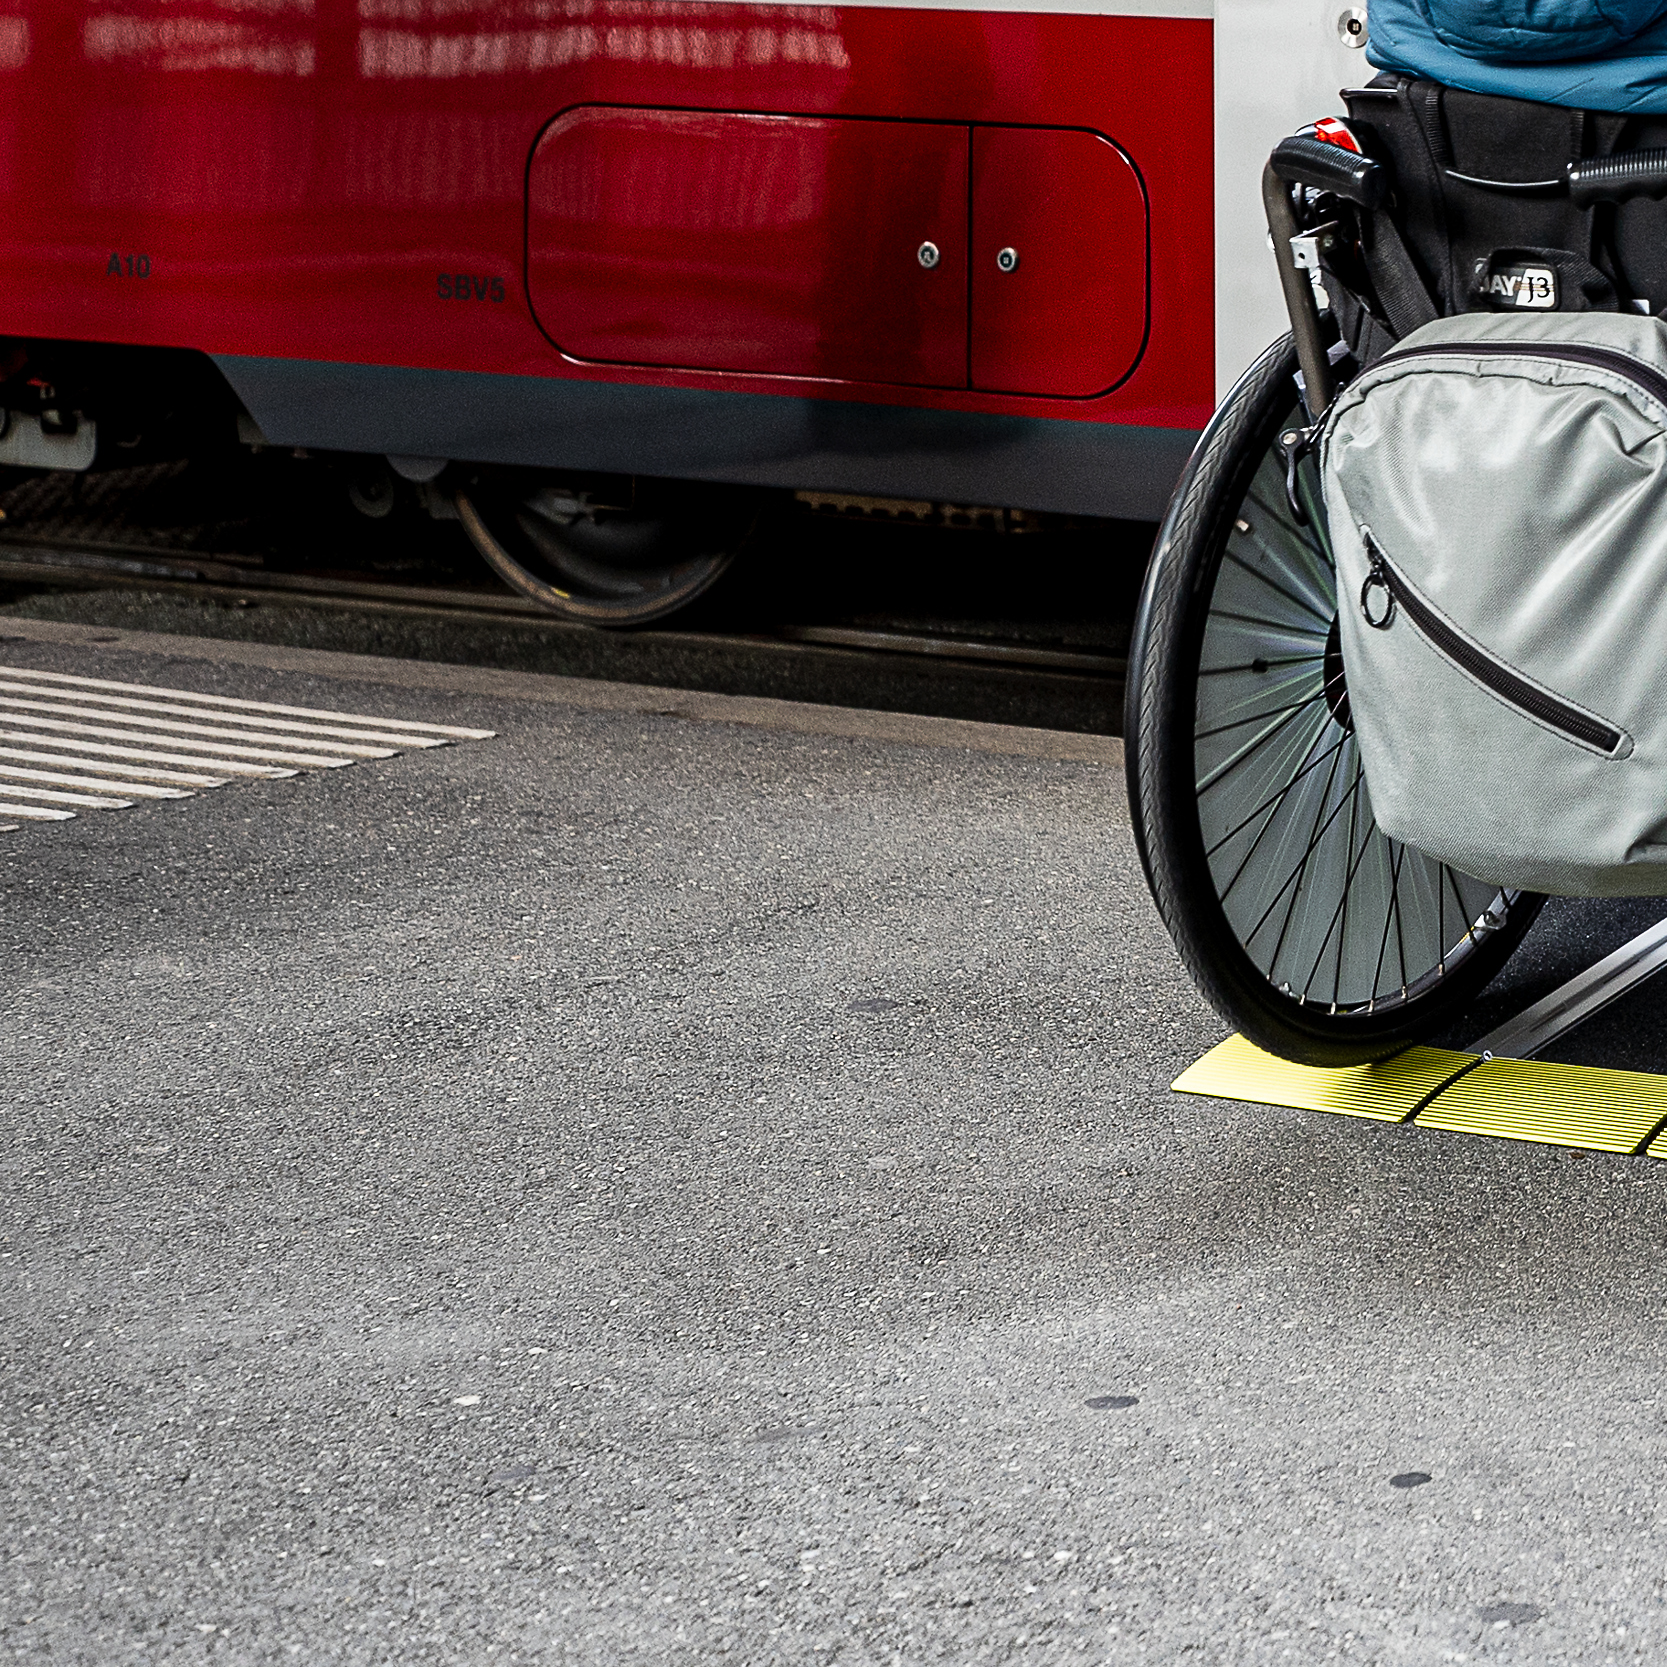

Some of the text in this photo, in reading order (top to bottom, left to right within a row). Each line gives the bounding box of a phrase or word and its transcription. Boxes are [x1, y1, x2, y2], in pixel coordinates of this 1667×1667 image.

[106, 252, 151, 279] A10
[436, 272, 506, 303] SBV5
[1479, 274, 1551, 304] JAY J3
